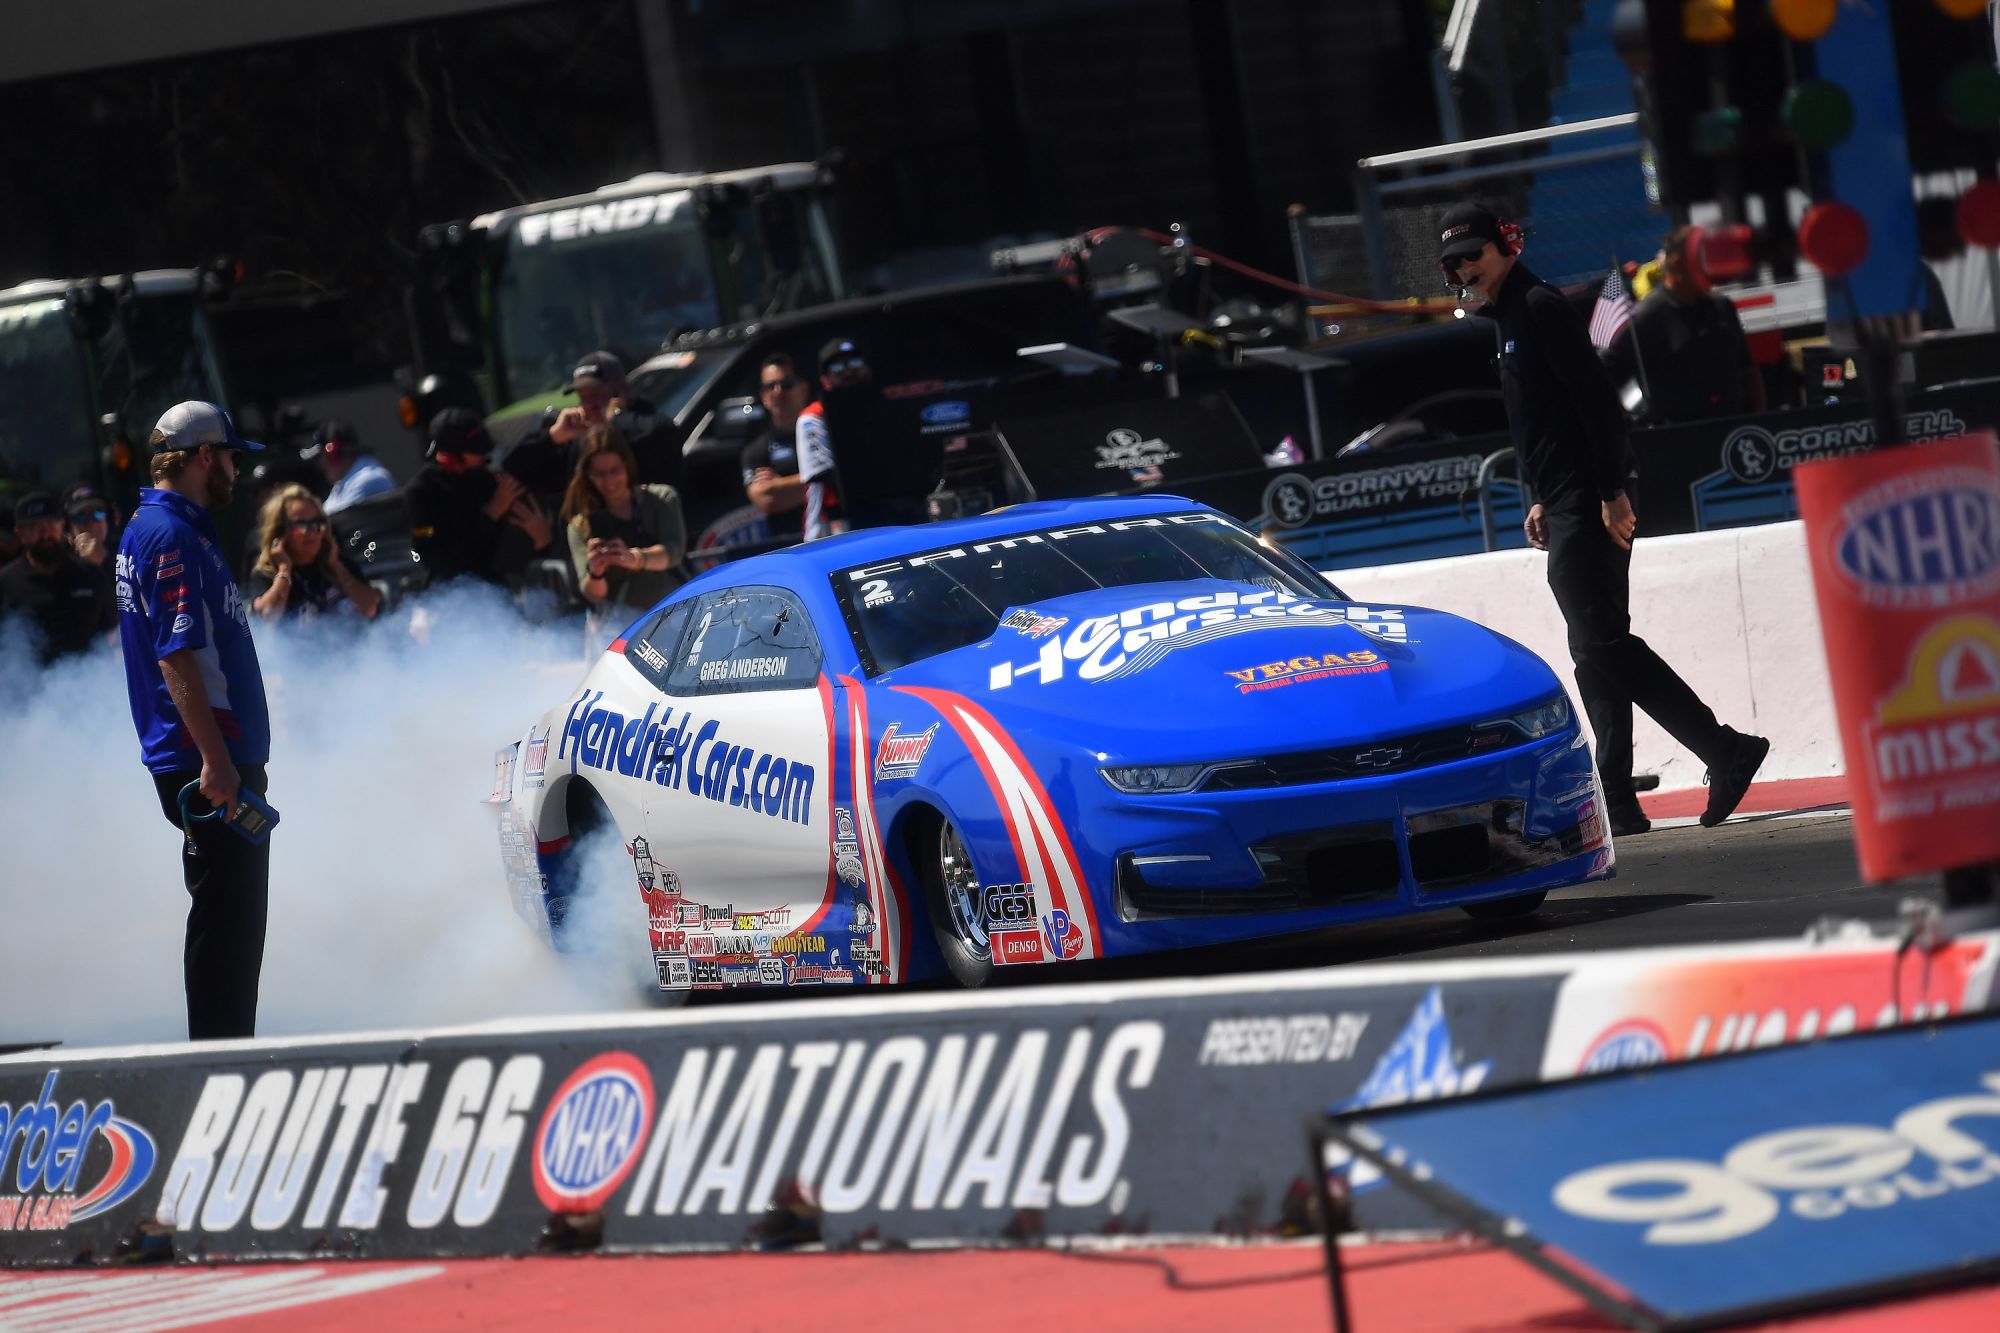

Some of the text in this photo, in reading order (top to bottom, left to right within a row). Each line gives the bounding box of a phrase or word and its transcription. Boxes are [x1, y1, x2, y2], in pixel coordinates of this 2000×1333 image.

[518, 190, 694, 246] FENDT
[1777, 411, 1955, 450] CORNELL
[1315, 490, 1407, 514] QUALITY
[848, 514, 1222, 581] CAMARO
[1856, 489, 2000, 586] NHR
[860, 579, 894, 602] 2
[865, 594, 895, 609] PRO
[692, 612, 712, 653] 2
[686, 653, 699, 667] PRO
[701, 656, 788, 681] GREG ANDERSON
[1224, 649, 1379, 683] VEGAS
[1240, 663, 1391, 695] GENERAL CONSTRUCTION
[877, 725, 930, 768] SUMMIT
[649, 919, 672, 929] TOOLS
[704, 904, 733, 920] Browell
[763, 909, 791, 925] SCOTT
[650, 931, 686, 951] ARP
[689, 936, 714, 955] SIMPSON
[714, 935, 753, 955] DIAMOND
[1042, 909, 1071, 959] VP
[1063, 936, 1083, 952] Racing
[1008, 940, 1038, 954] DENSO
[659, 961, 672, 985] ATI
[672, 962, 686, 973] SUPER
[690, 961, 722, 983] JESEL
[1198, 1013, 1369, 1066] PRESENTED BY
[625, 1020, 1165, 1217] NATIONALS
[156, 1054, 544, 1232] ROUTE 66
[543, 1075, 638, 1190] NHRA
[29, 1194, 77, 1231] GLASS
